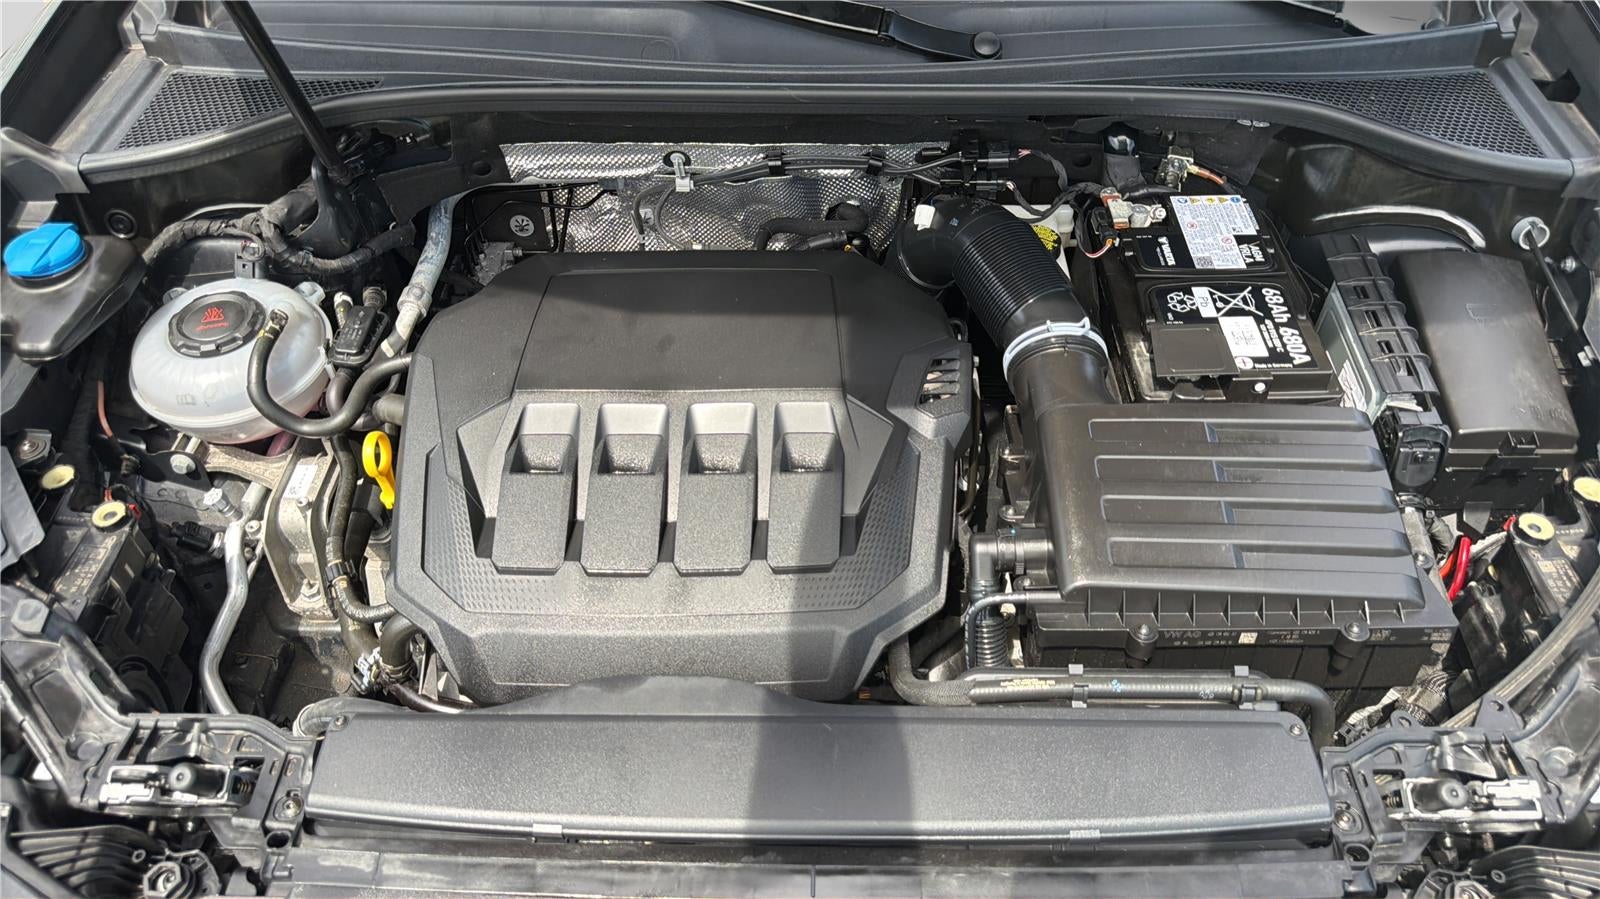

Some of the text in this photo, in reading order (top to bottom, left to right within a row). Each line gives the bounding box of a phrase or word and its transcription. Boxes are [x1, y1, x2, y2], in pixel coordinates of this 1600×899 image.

[1161, 243, 1176, 266] VARTA
[1239, 244, 1255, 263] VRLA
[1249, 245, 1265, 262] AGM
[1200, 296, 1209, 308] Pb
[1262, 287, 1291, 323] 68Ah
[1278, 327, 1312, 365] 680A
